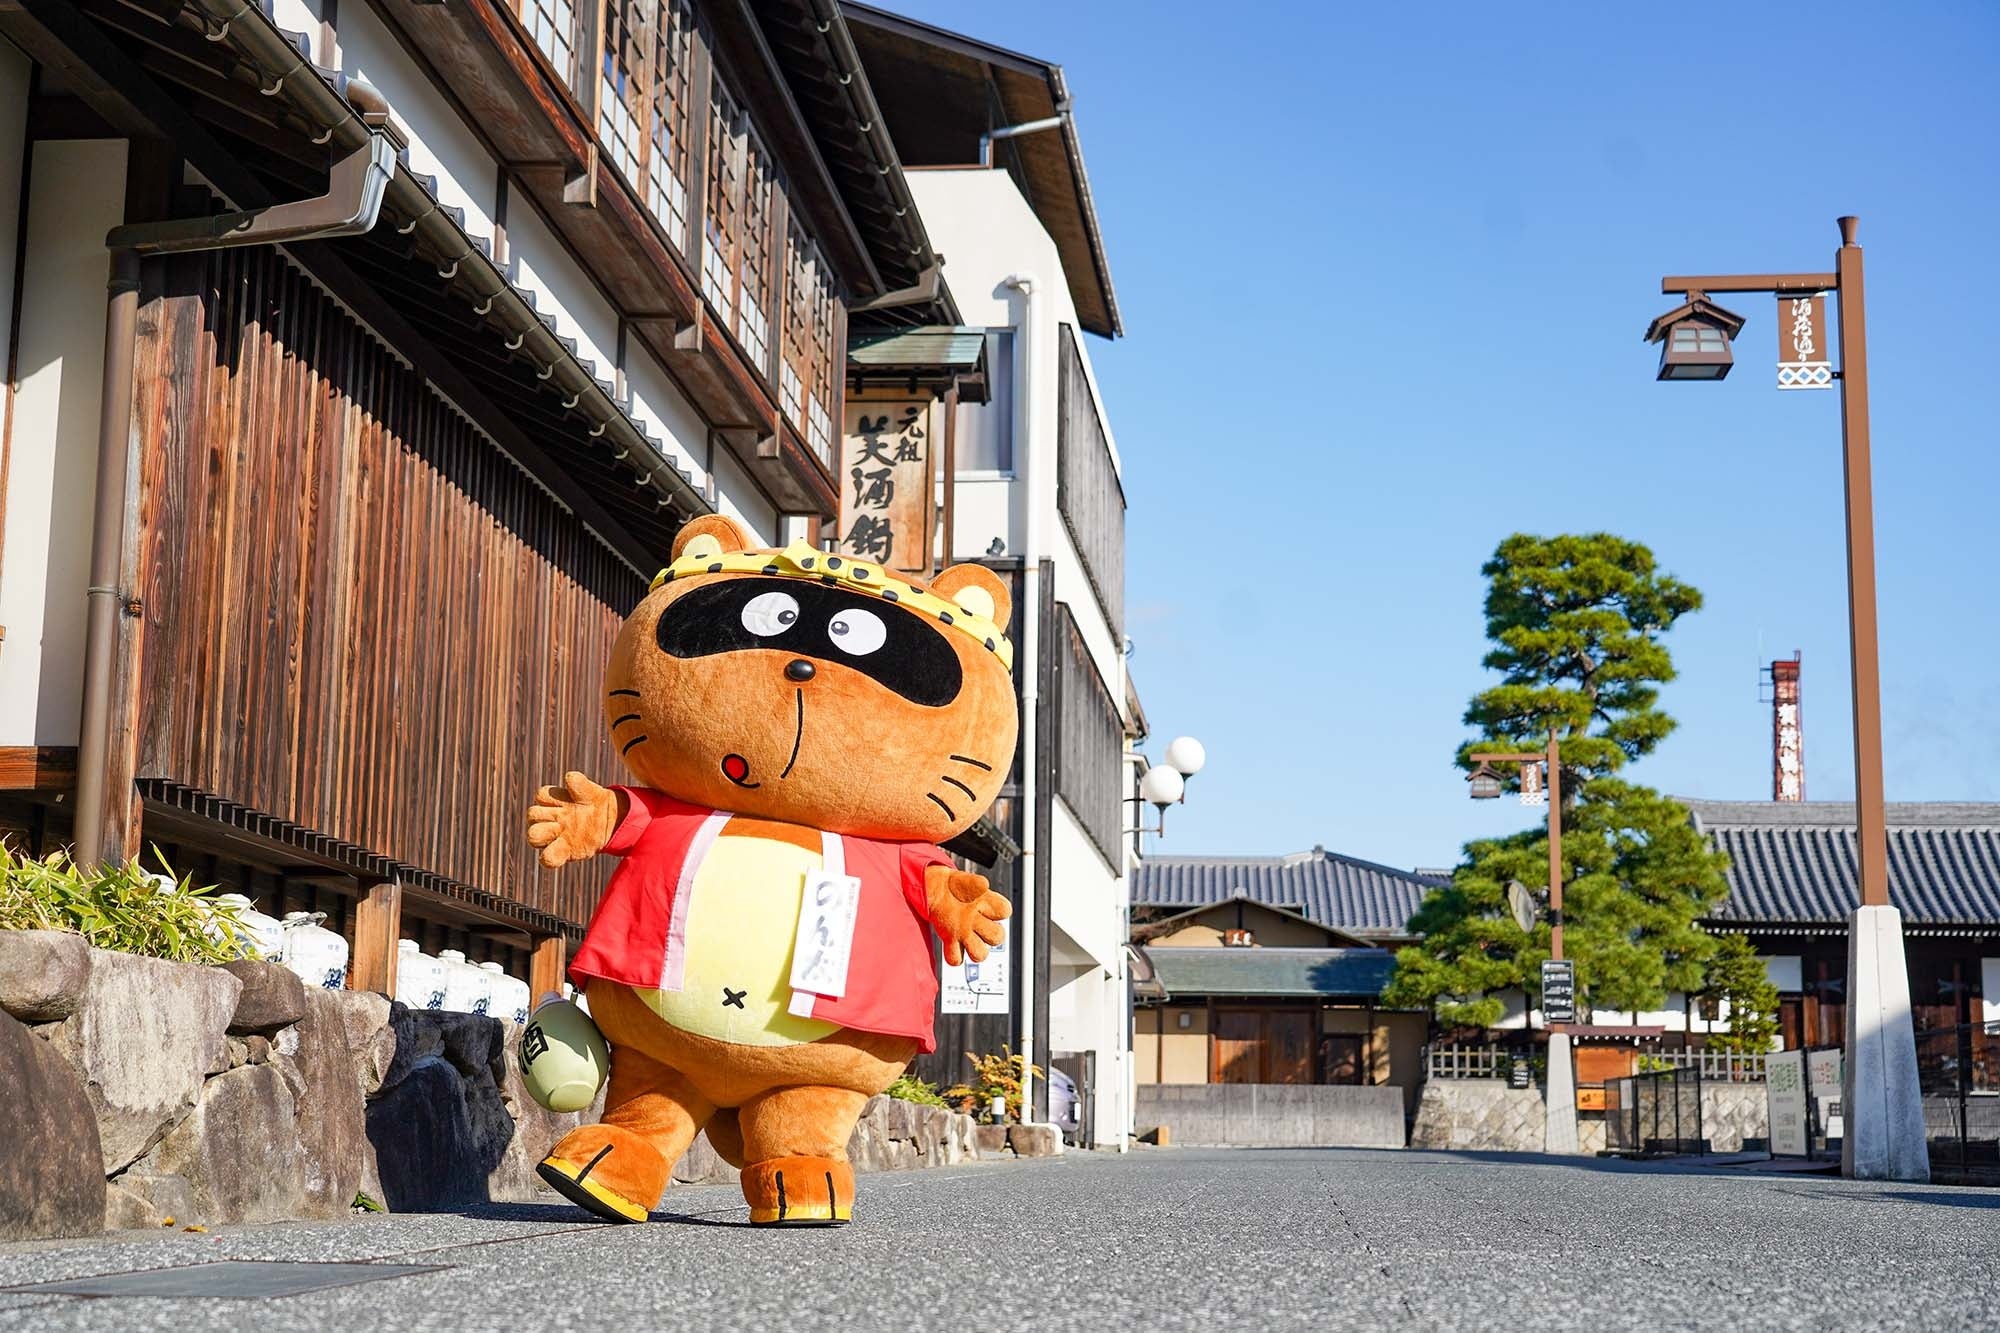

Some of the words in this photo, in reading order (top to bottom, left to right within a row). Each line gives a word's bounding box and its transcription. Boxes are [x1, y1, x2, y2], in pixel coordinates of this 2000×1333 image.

[893, 406, 925, 462] 元祖
[842, 414, 897, 565] 美酒鍋
